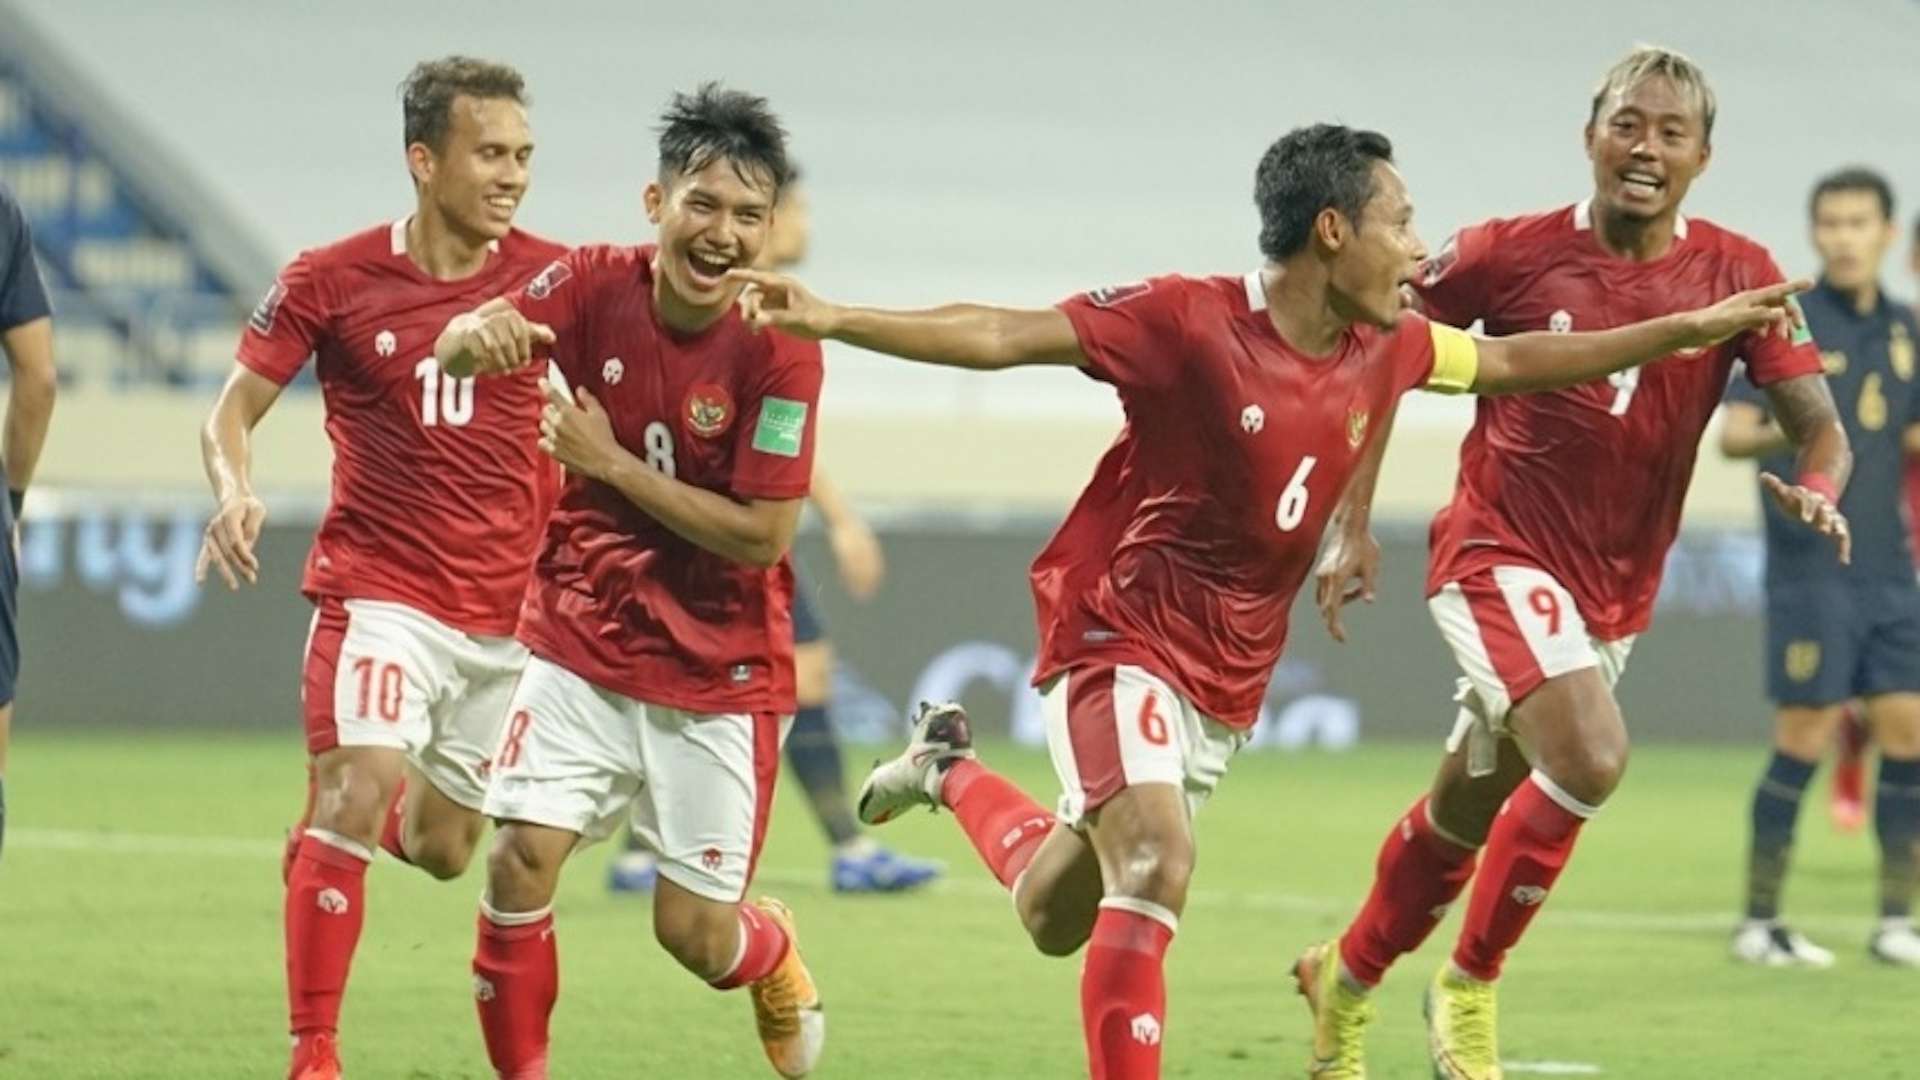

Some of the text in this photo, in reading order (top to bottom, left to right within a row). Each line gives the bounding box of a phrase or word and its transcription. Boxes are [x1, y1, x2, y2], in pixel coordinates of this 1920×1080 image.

[1857, 371, 1888, 431] 6
[644, 421, 677, 479] 8
[1275, 456, 1317, 532] 6
[1528, 588, 1561, 637] 9
[354, 657, 403, 722] 10
[1139, 688, 1169, 746] 6
[499, 710, 529, 768] 8
